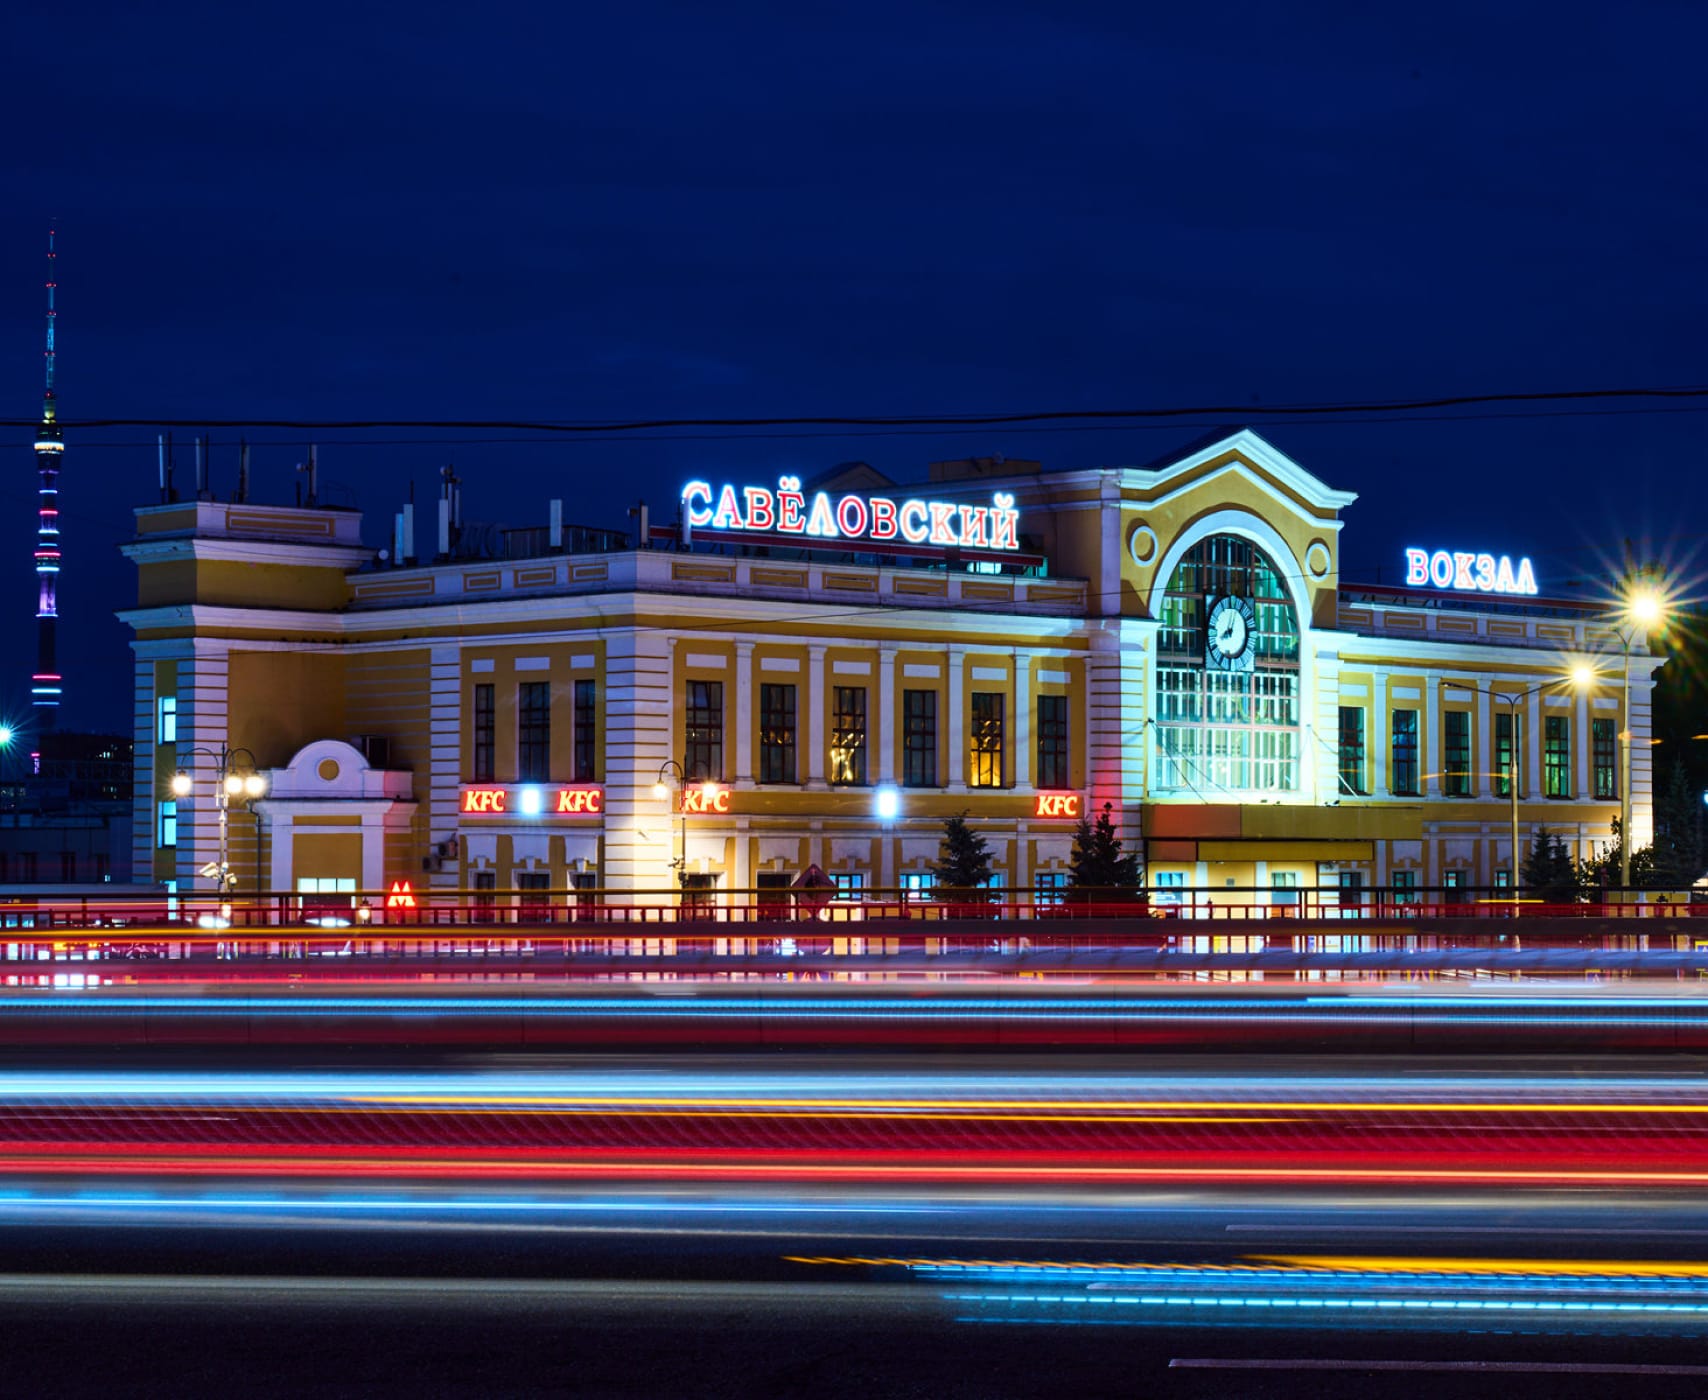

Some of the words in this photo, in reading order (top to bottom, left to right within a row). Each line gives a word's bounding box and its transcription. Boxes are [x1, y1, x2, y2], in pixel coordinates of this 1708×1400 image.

[682, 476, 1019, 550] САВЁЛОВСКИЙ
[1406, 548, 1538, 595] ВОКЗАЛ
[464, 790, 505, 811] KFC
[557, 790, 600, 812] KFC
[684, 789, 729, 812] KFC
[1036, 795, 1078, 815] KFC
